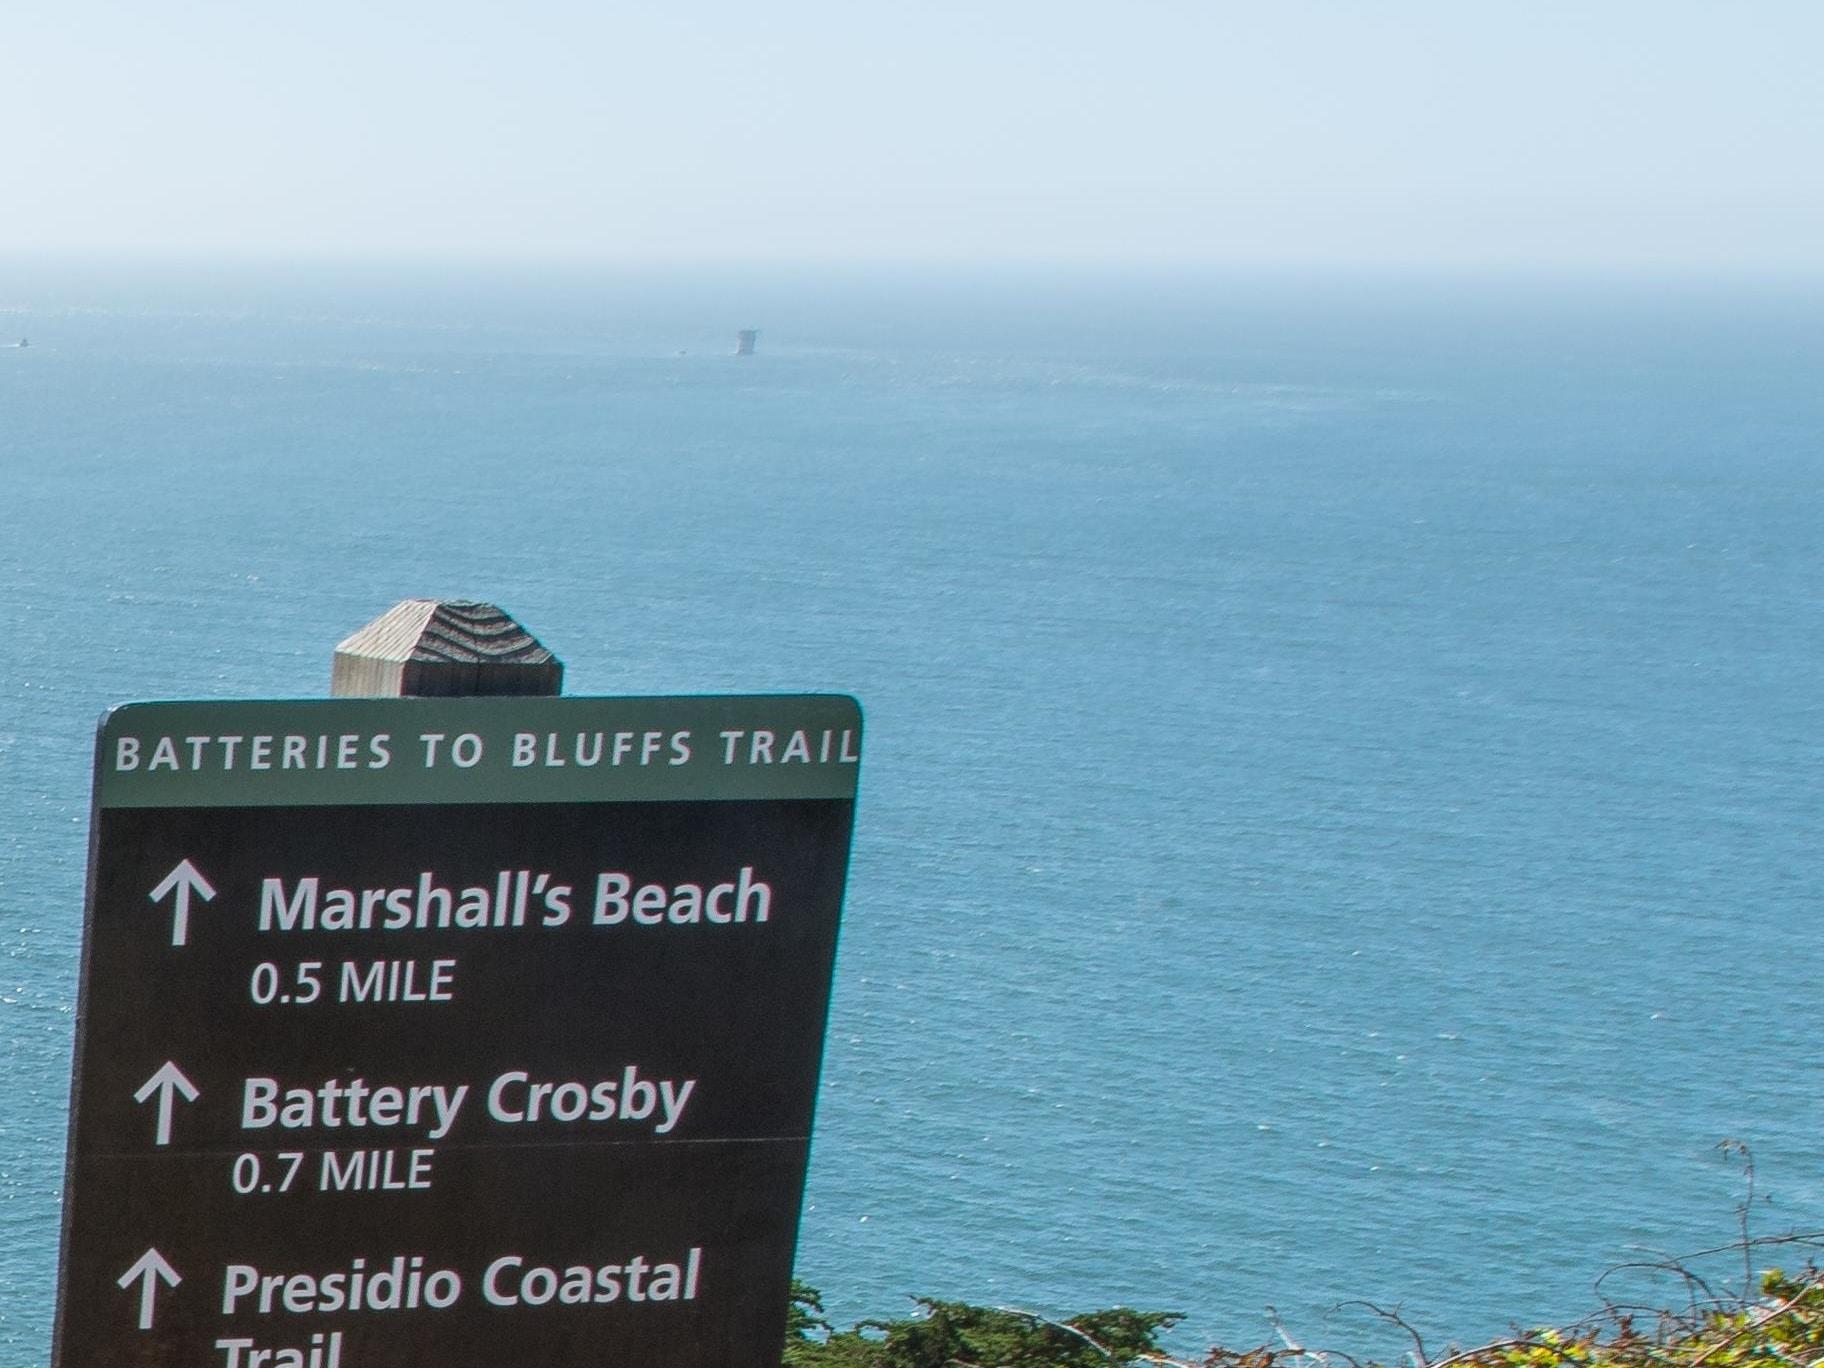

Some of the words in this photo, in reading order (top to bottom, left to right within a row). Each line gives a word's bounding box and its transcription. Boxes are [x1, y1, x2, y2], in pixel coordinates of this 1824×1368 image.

[116, 733, 391, 771] BATTERIES
[420, 733, 483, 768] TO
[512, 730, 691, 767] BLUFFS
[720, 729, 858, 765] TRAIL
[259, 870, 572, 931] Marshall's
[593, 866, 771, 925] Beach
[251, 961, 322, 1005] 0.5
[339, 959, 456, 1003] MILE
[242, 1077, 469, 1139] Battery
[488, 1065, 696, 1134] Crosby
[233, 1152, 304, 1194] 0.7
[320, 1148, 435, 1191] MILE
[222, 1256, 461, 1315] Presidio
[483, 1247, 702, 1306] Coastal
